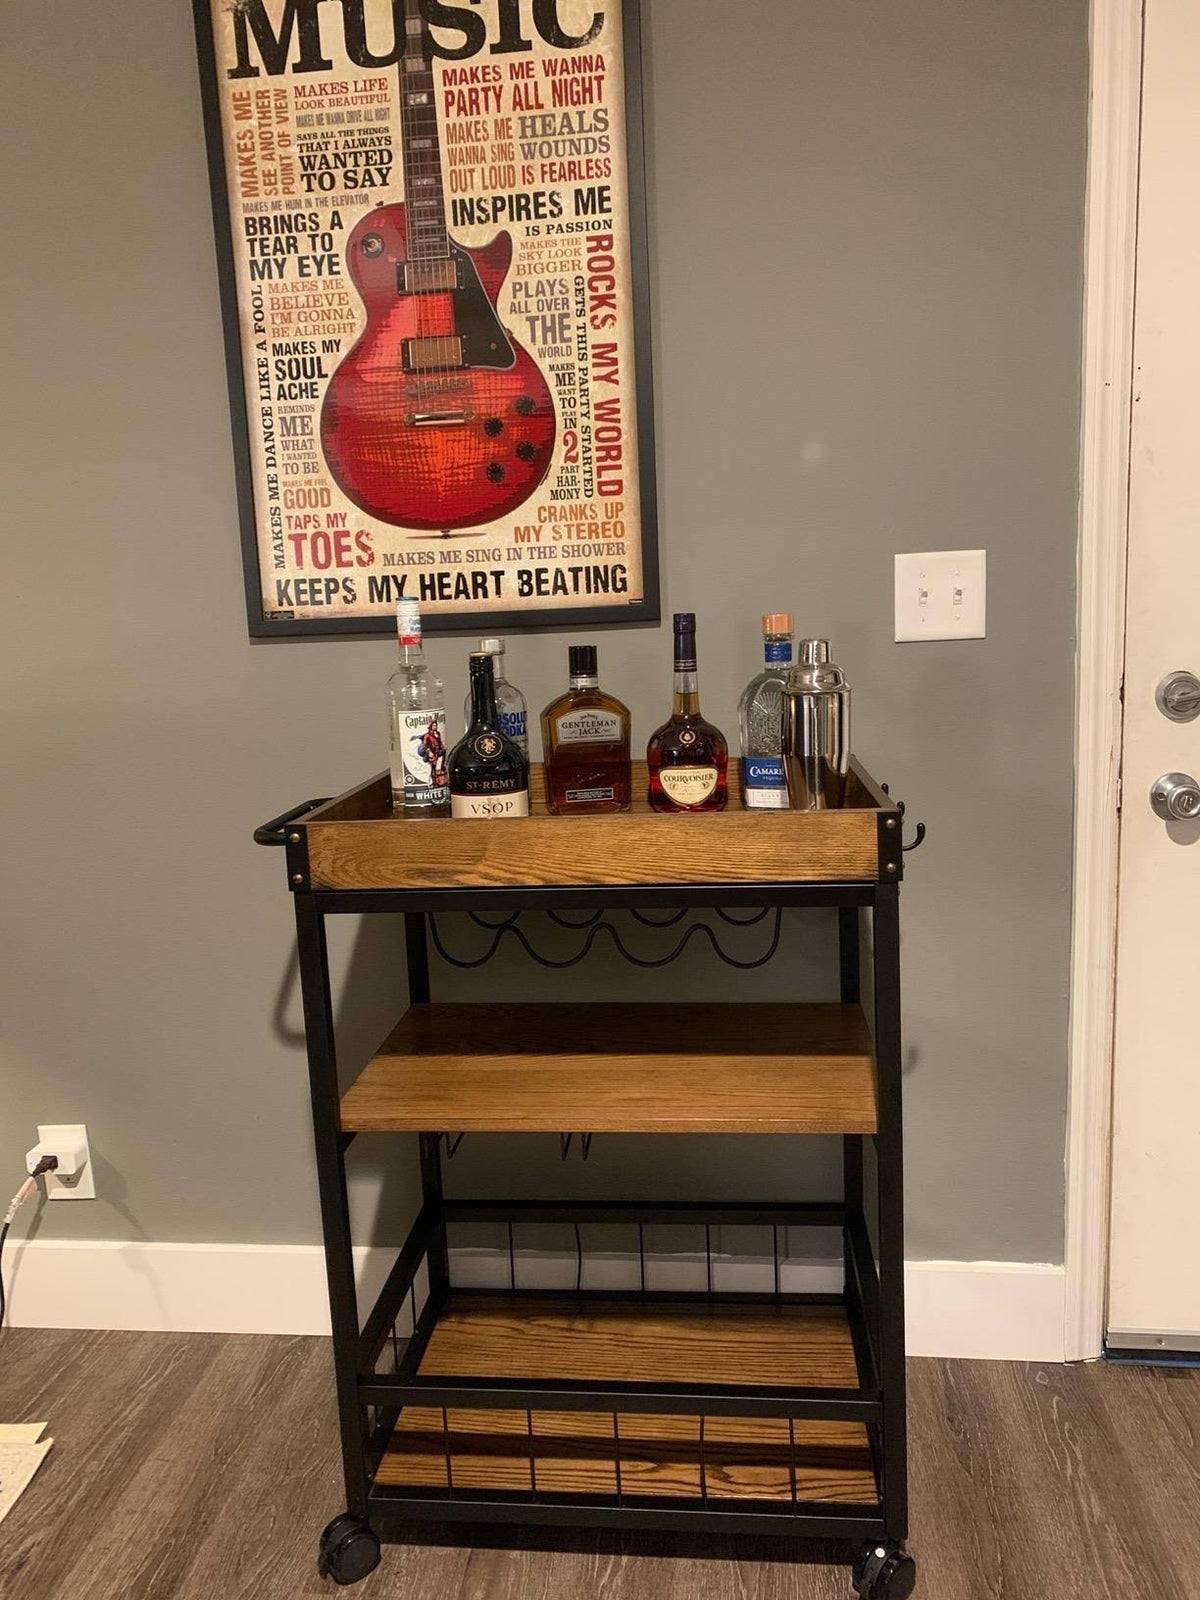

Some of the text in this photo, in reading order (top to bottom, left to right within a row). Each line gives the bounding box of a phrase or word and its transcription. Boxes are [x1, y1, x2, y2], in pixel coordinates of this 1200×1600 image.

[227, 0, 604, 79] MUSIC
[442, 54, 606, 87] MAKES ME WANNA
[293, 77, 388, 98] MAKES LIFE
[444, 75, 605, 118] PARTY ALL NIGHT
[294, 93, 391, 110] LOOK BEAUTIFUL
[296, 126, 389, 141] SAYS ALL THE THINGS
[445, 118, 513, 145] MAKES ME
[517, 108, 609, 139] HEALS
[232, 90, 259, 198] MAKES ME
[255, 89, 278, 196] SEE ANOTHER
[273, 88, 295, 195] POINT OF VIEW
[297, 135, 392, 153] THAT I ALWAYS
[519, 135, 611, 160] WOUNDS
[298, 148, 393, 172] WANTED
[447, 142, 515, 166] WANNA SING
[300, 166, 392, 192] TO SAY
[450, 164, 516, 193] OUT LOUD
[521, 157, 612, 185] IS FEARLESS
[242, 193, 369, 213] MAKES ME HUM IN THE ELEVATOR
[451, 185, 612, 227] INSPIRES ME
[244, 210, 344, 236] BRINGS A
[525, 219, 613, 237] IS PASSION
[246, 232, 333, 257] TEAR TO
[520, 237, 581, 250] MAKES THE
[519, 247, 582, 262] SKY LOOK
[249, 253, 341, 281] MY EYE
[516, 259, 583, 276] BIGGER
[268, 278, 344, 294] MAKES ME
[512, 278, 569, 299] PLAYS
[269, 292, 349, 310] BELIEVE
[510, 297, 570, 314] ALL OVER
[270, 308, 356, 325] I'M GONNA
[271, 322, 356, 338] BE ALRIGHT
[526, 312, 572, 345] THE
[272, 339, 341, 357] MAKES MY
[537, 345, 572, 359] WORLD
[275, 356, 328, 381] SOUL
[549, 362, 575, 372] MAKES
[586, 234, 623, 497] ROCKS MY WORLD
[555, 372, 576, 387] ME
[574, 275, 594, 498] GETS THIS PARTY STARTED
[277, 382, 319, 401] ACHE
[277, 404, 315, 415] REMINDS
[559, 397, 577, 409] TO
[251, 285, 285, 569] MAKES ME DANCE LIKE A FOOL
[278, 415, 313, 437] ME
[563, 418, 577, 429] IN
[280, 438, 315, 451] WHAT
[562, 430, 579, 464] 2
[286, 452, 317, 461] WANTED
[282, 461, 319, 475] TO BE
[560, 465, 580, 474] PART
[283, 487, 331, 510] GOOD
[550, 488, 580, 501] MONY
[285, 512, 347, 530] TAPS MY
[537, 502, 625, 524] CRANKS UP
[513, 520, 625, 543] MY STEREO
[287, 529, 375, 570] TOES
[382, 542, 627, 567] MAKES ME SING IN THE SHOWER
[275, 563, 628, 606] KEEPS MY HEART BEATING
[561, 719, 617, 730] GENTLEMAN
[578, 728, 601, 737] JACK
[663, 773, 714, 785] COURVOISIER
[415, 789, 443, 801] WHITE
[471, 801, 513, 815] VSOP
